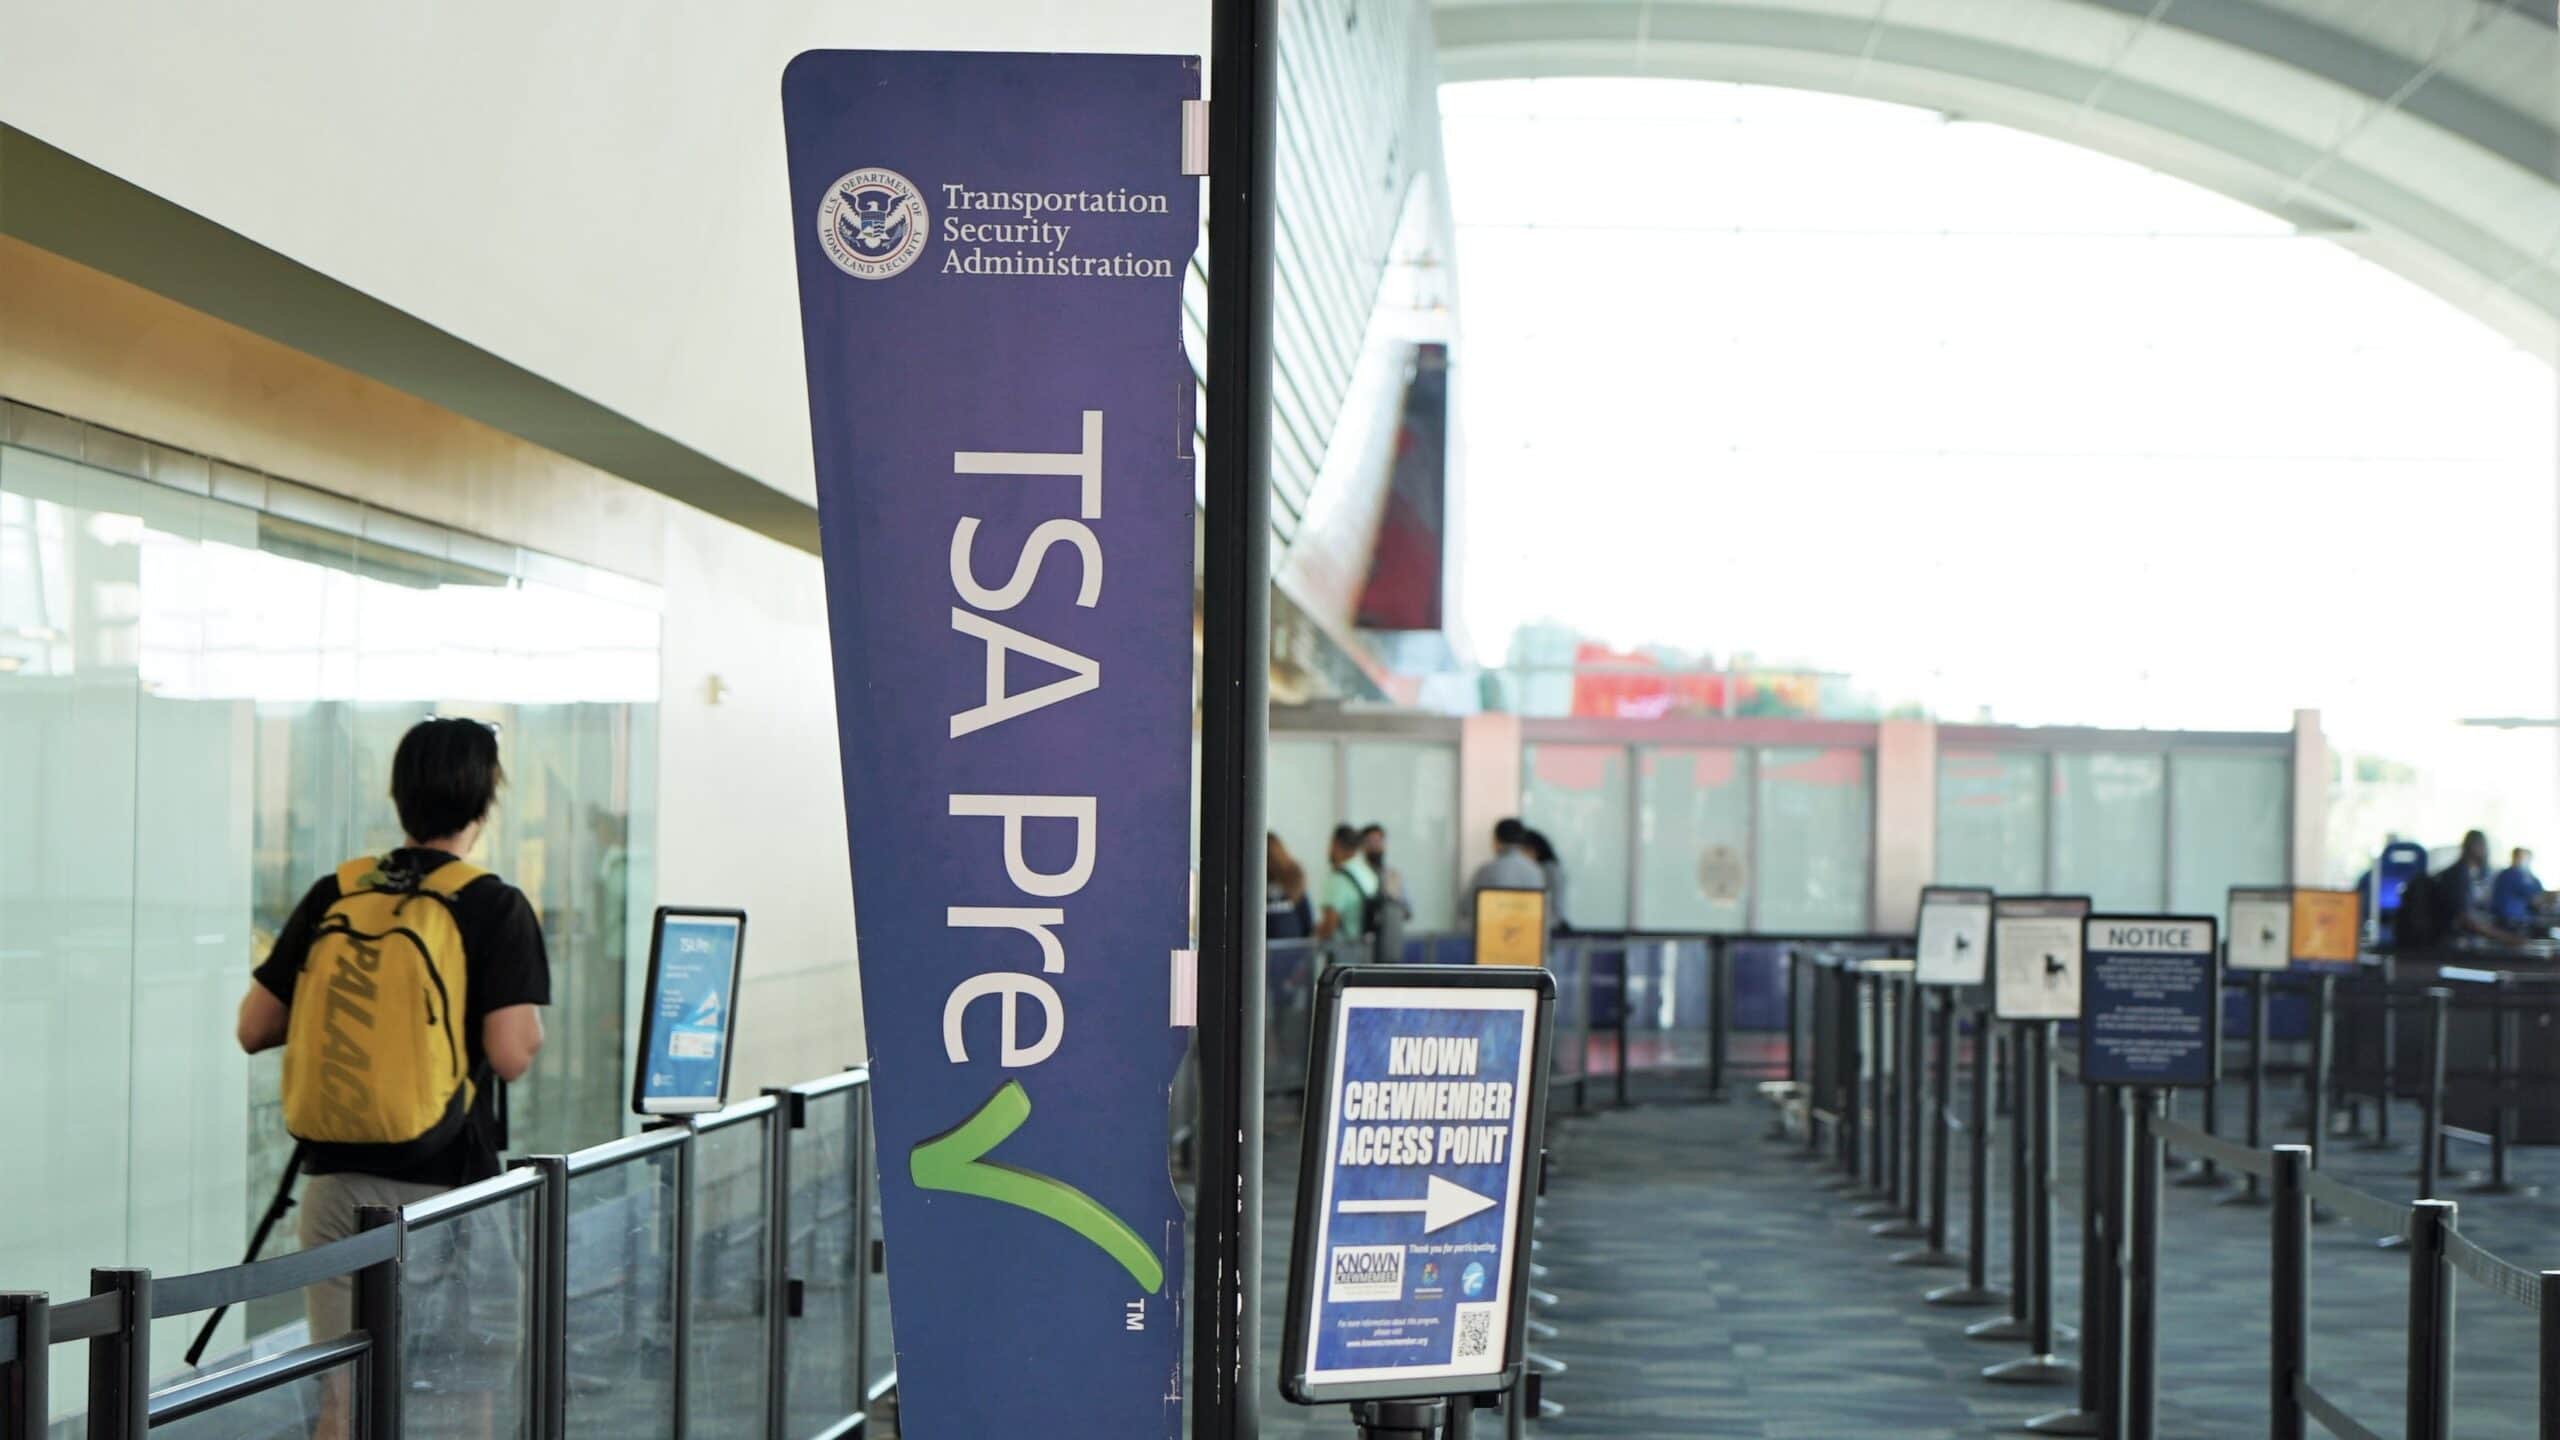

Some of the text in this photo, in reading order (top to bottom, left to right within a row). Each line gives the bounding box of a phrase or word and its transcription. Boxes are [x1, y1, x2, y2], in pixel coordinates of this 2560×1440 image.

[841, 173, 914, 201] DEPARTMENT
[911, 201, 922, 217] OF
[942, 183, 1169, 219] Transportation
[823, 228, 923, 274] HOMELAND SECURITY
[943, 216, 1071, 251] Security
[941, 247, 1174, 277] Administration
[942, 410, 1145, 1330] TSA Pre TM
[2108, 927, 2192, 948] NOTICE
[318, 934, 384, 1138] PALACE
[1388, 1036, 1479, 1076] KNOWN
[1344, 1081, 1513, 1120] CREWMEMBER
[1339, 1126, 1508, 1166] ACCESS POINT
[1335, 1252, 1400, 1274] KNOWN
[1408, 1243, 1429, 1254] Thank
[1430, 1245, 1442, 1256] you
[1442, 1243, 1454, 1256] for
[1335, 1272, 1398, 1284] CREWMEMBER
